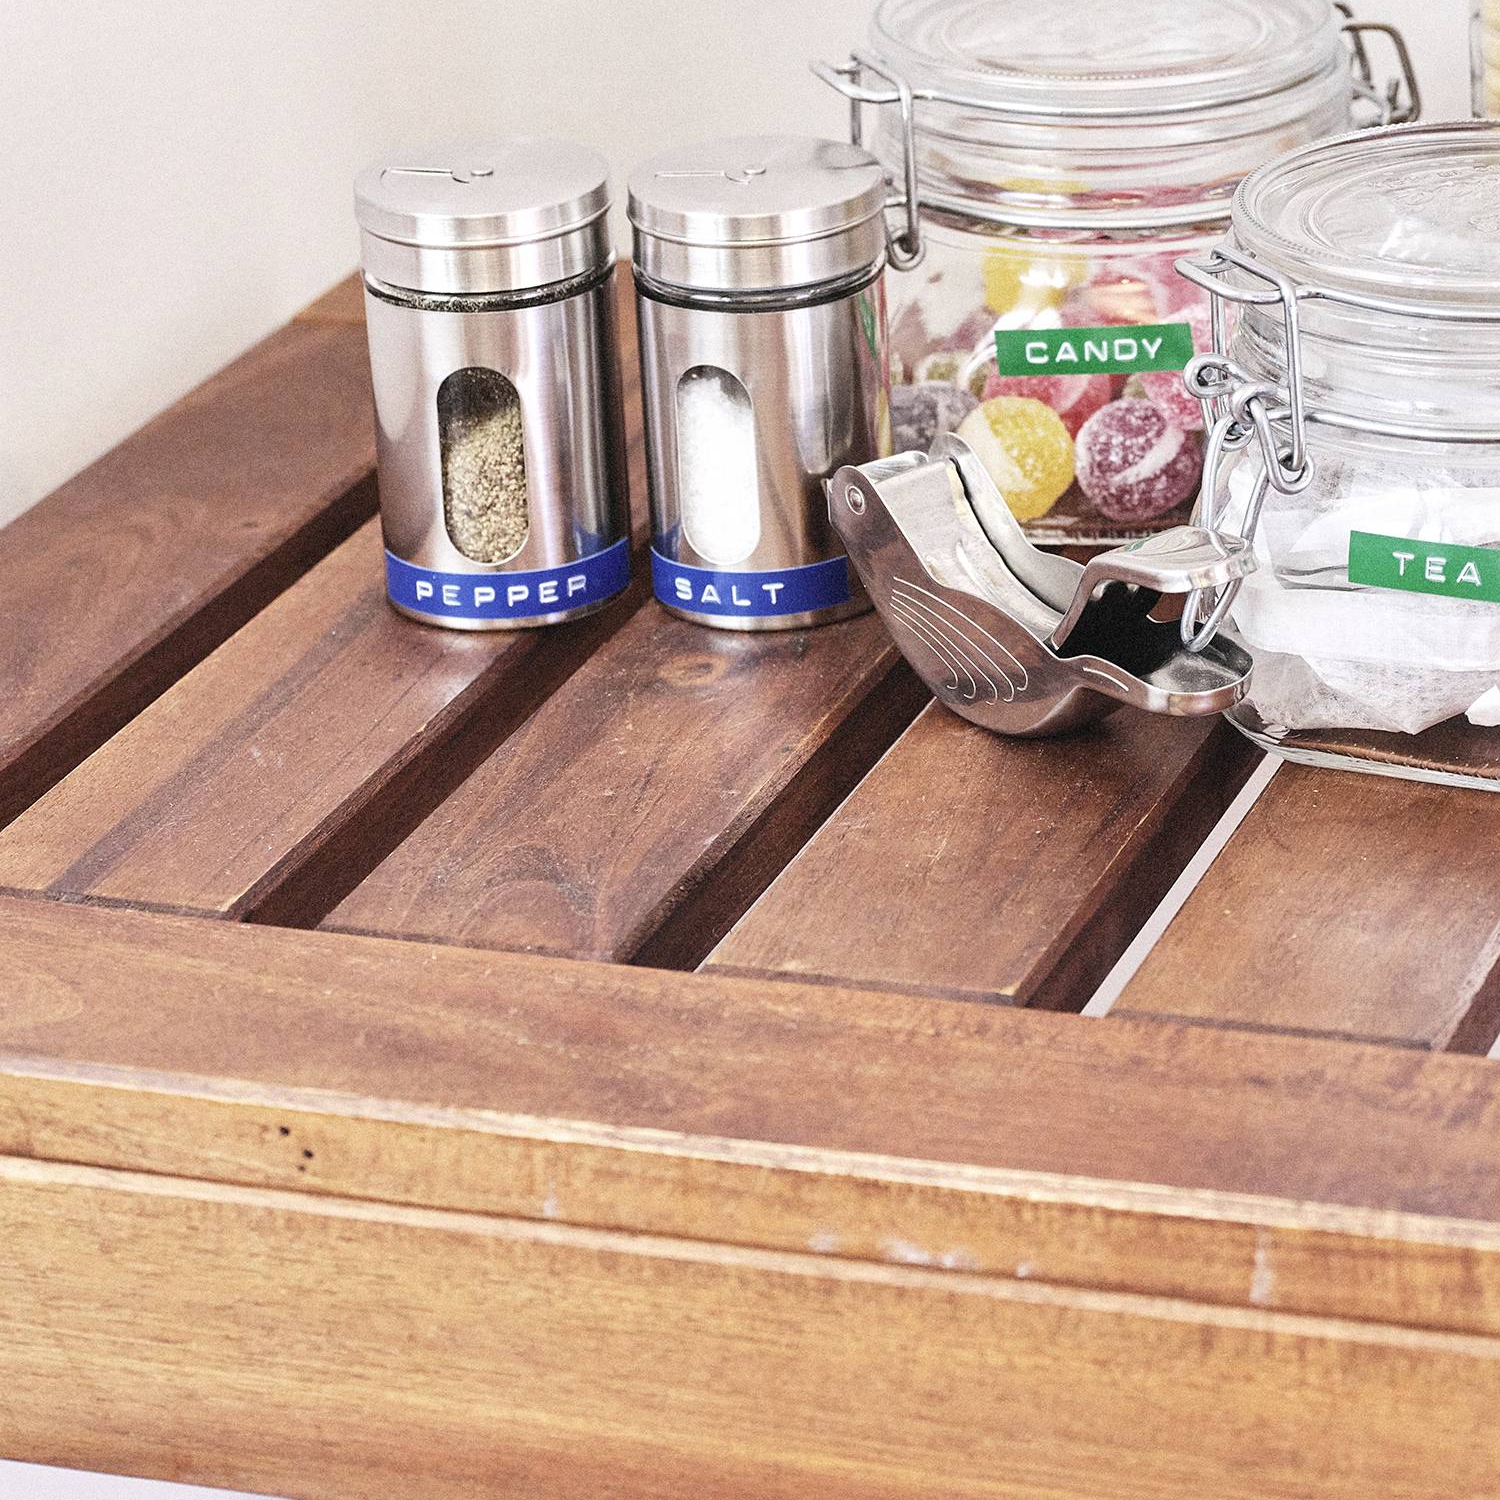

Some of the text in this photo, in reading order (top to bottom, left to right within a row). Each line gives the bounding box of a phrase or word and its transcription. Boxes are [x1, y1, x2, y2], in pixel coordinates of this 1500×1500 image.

[1024, 337, 1163, 365] CANDY
[1392, 551, 1482, 587] TEA
[415, 574, 588, 608] PEPPER
[674, 577, 785, 607] SALT
